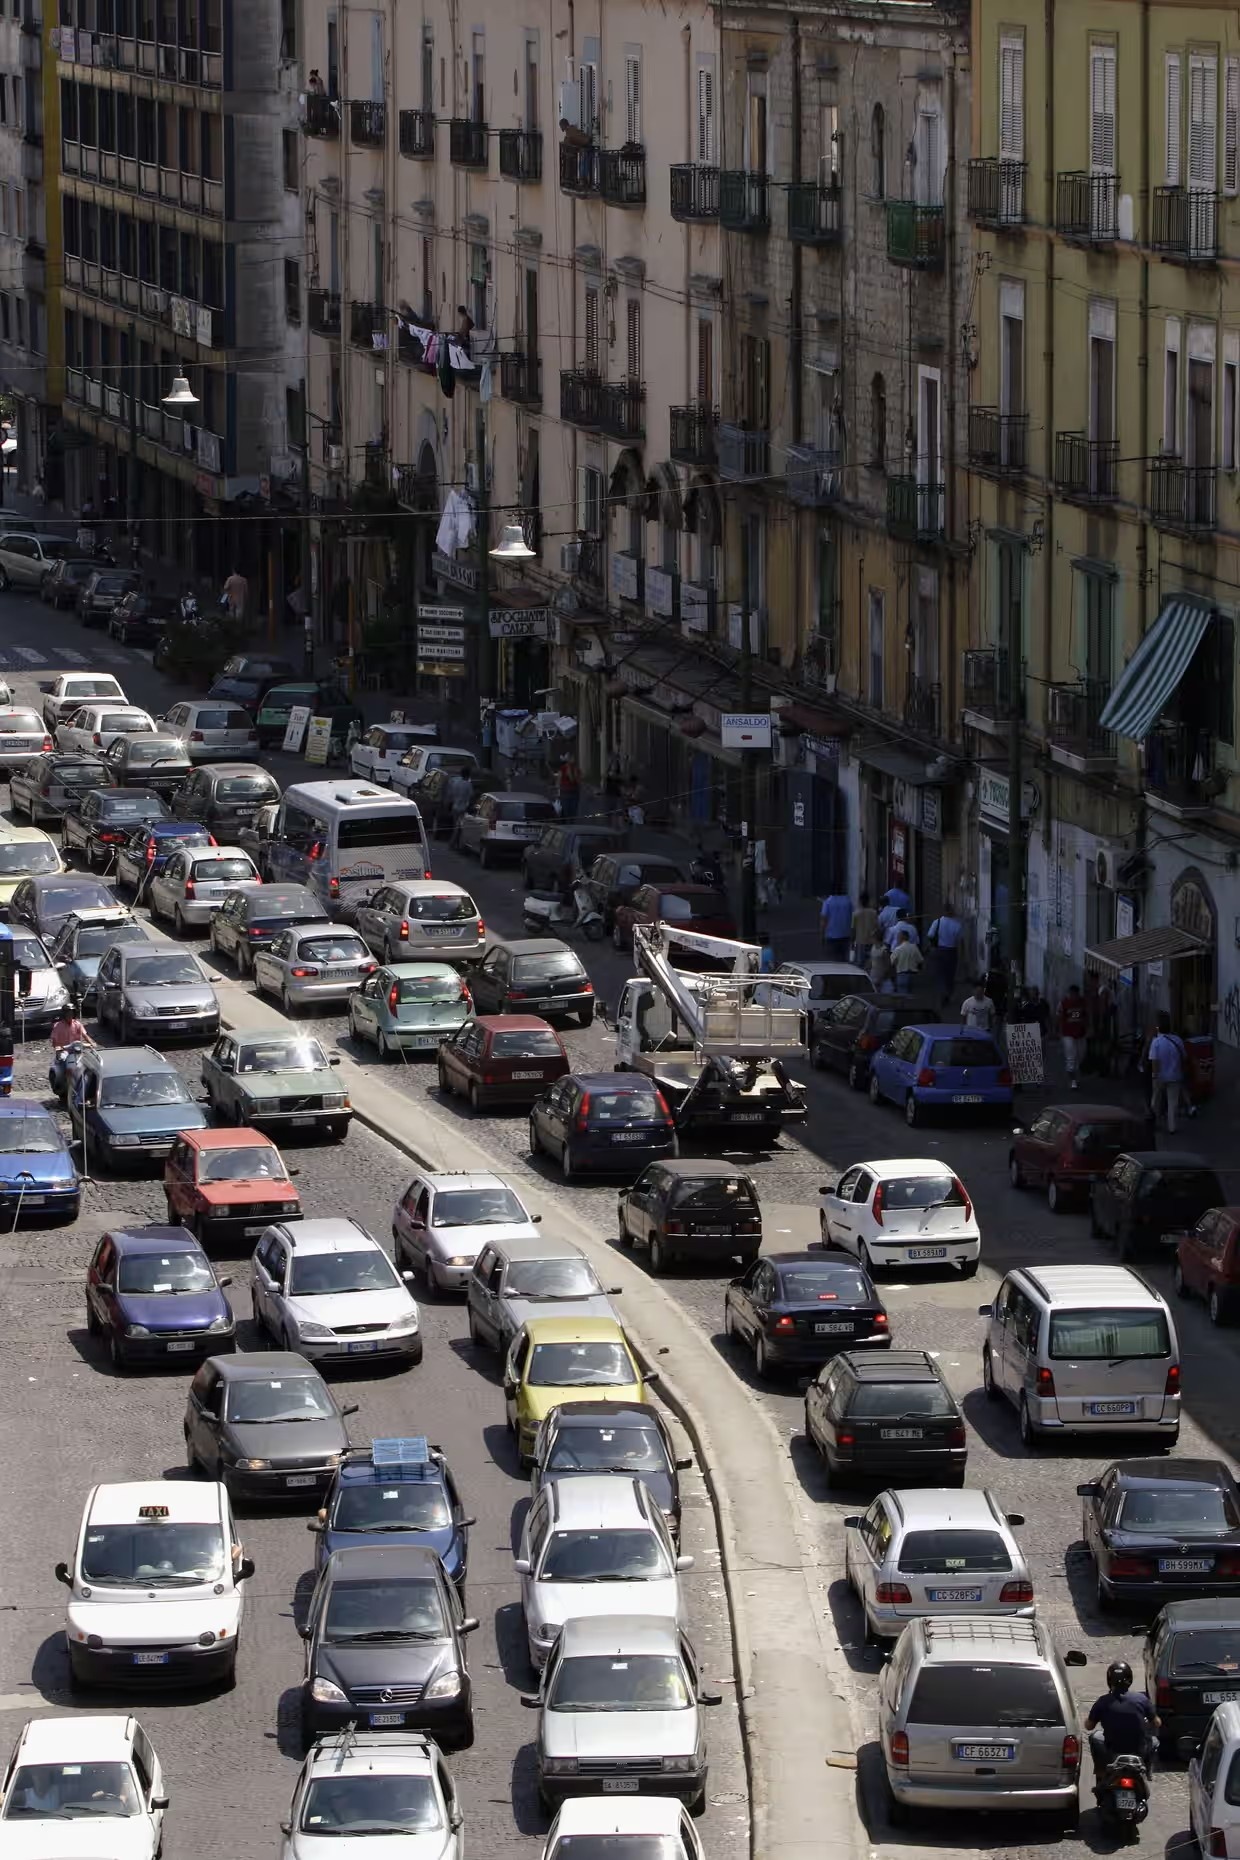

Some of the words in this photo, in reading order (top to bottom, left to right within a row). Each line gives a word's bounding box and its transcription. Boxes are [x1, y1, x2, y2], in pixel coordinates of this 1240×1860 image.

[726, 717, 767, 726] ANSALDO
[141, 1507, 168, 1516] TAXI
[1205, 1693, 1215, 1703] AL
[1219, 1692, 1237, 1702] 653
[964, 1747, 975, 1757] CF
